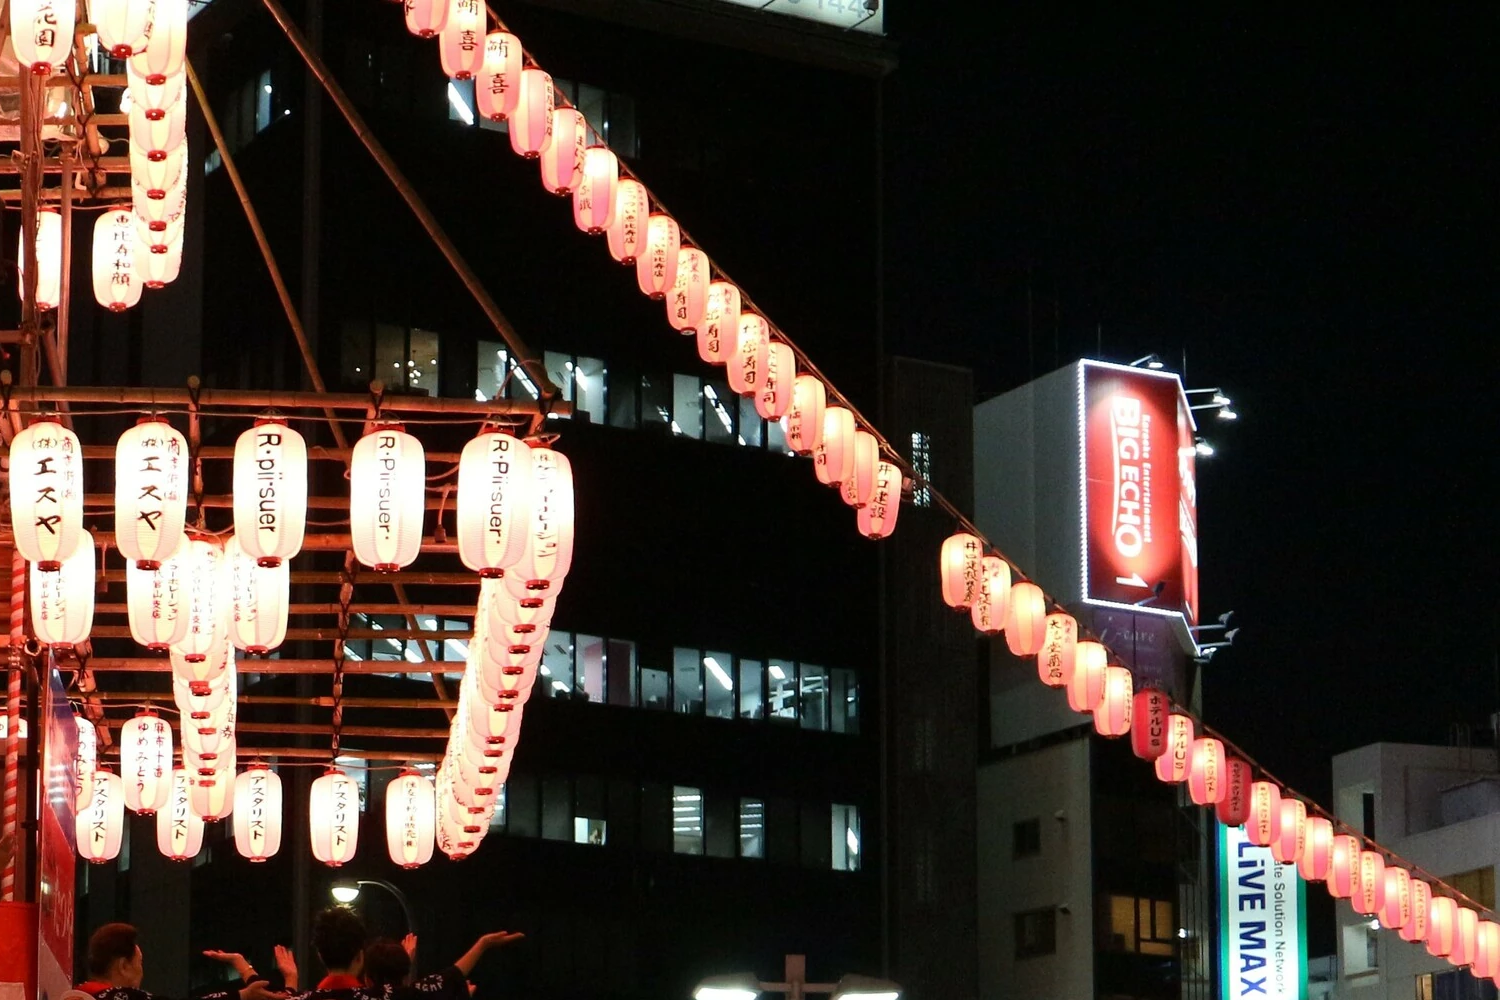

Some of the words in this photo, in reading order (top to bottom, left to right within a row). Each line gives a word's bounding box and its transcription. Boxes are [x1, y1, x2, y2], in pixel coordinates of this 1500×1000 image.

[1114, 396, 1141, 450] BIG
[1115, 466, 1143, 559] ECHO
[250, 774, 265, 841] アスタリスト
[333, 779, 349, 847] アスタリスト
[1237, 842, 1268, 911] LiVE
[1274, 883, 1287, 939] Solution
[1237, 922, 1268, 997] MAX
